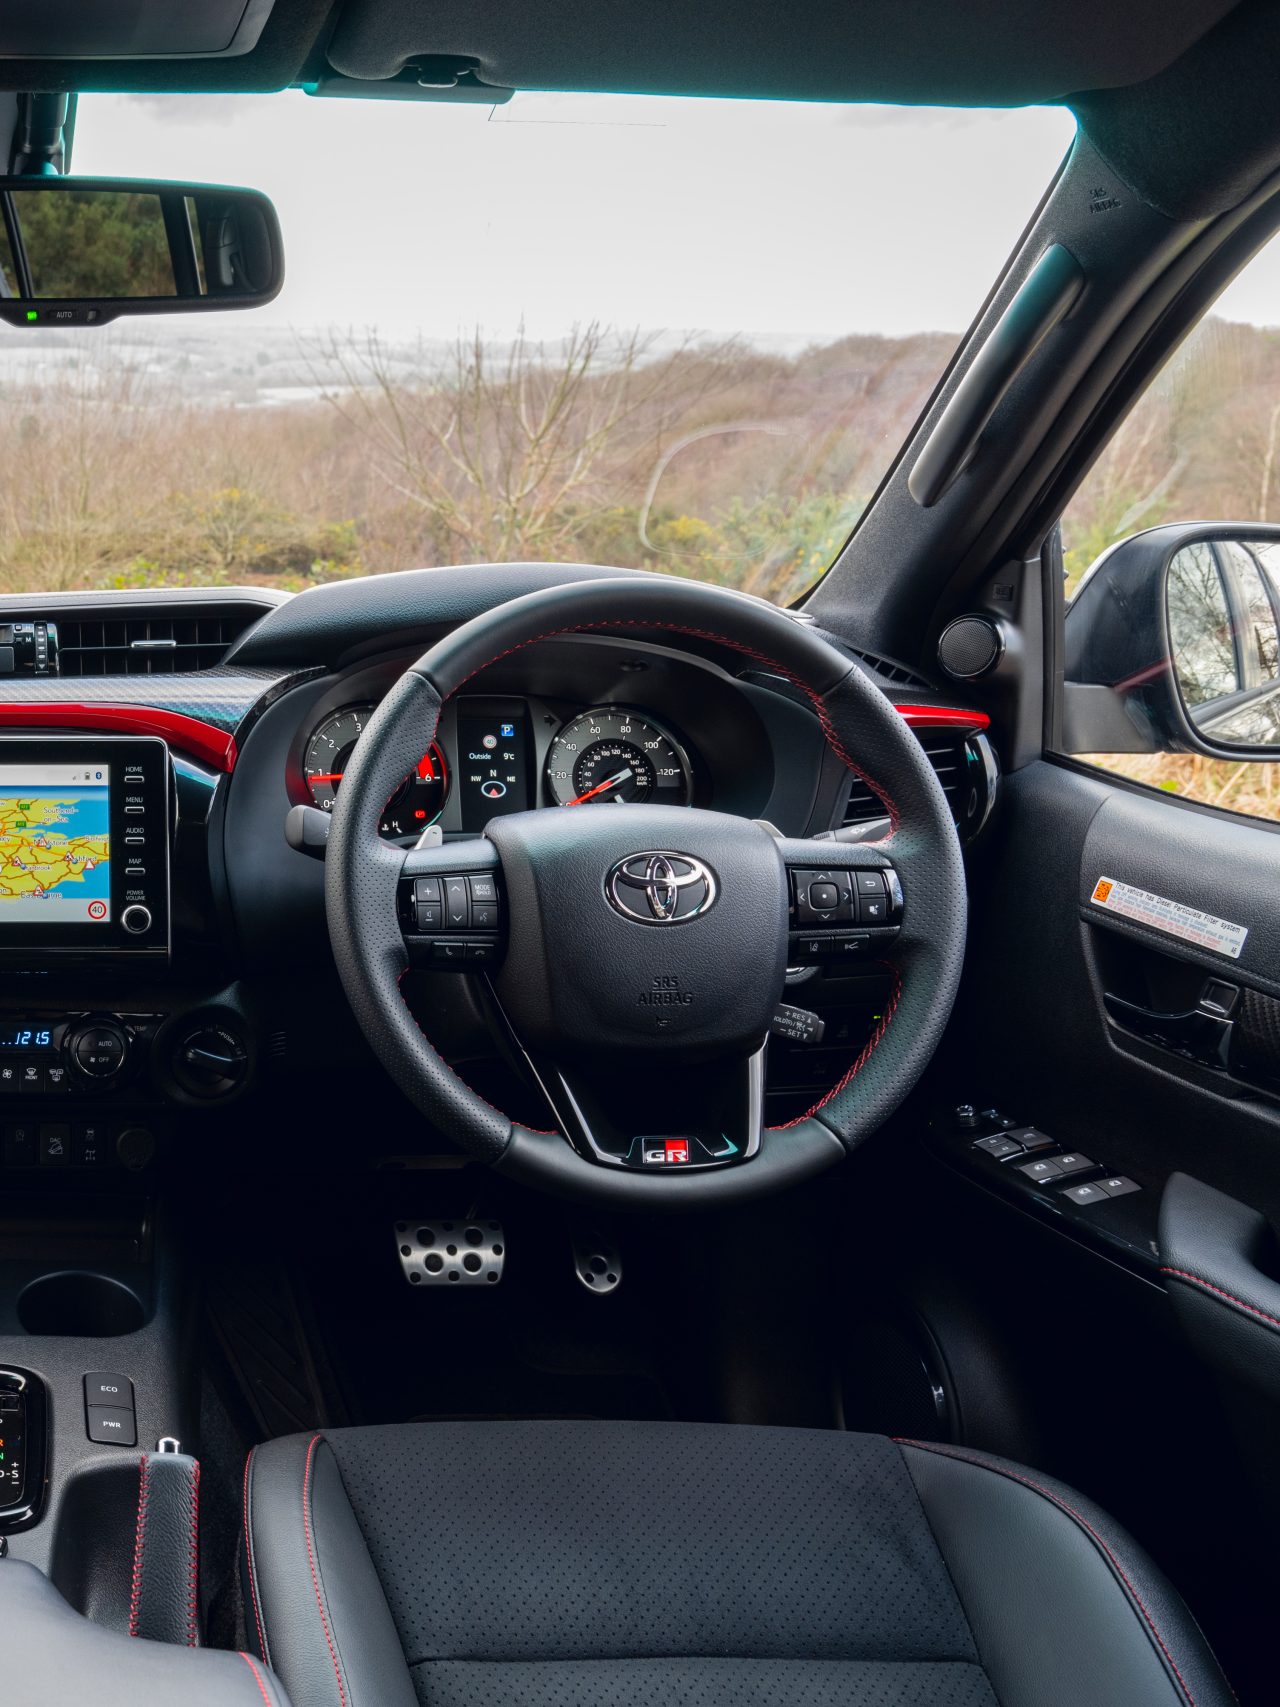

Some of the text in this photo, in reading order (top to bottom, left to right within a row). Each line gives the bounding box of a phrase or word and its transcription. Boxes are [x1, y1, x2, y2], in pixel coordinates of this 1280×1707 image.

[356, 723, 362, 732] 3
[328, 740, 335, 748] 2
[644, 741, 658, 749] 100
[318, 768, 323, 776] 1
[489, 769, 497, 777] N
[323, 800, 330, 808] 0
[1115, 882, 1241, 934] This vehicle has Diesel Particulate Filter system
[652, 976, 679, 988] SRS
[638, 992, 693, 1005] AIRBAG
[791, 1012, 806, 1022] RES
[787, 1028, 801, 1038] SET
[646, 1149, 688, 1161] GR
[100, 1385, 118, 1393] ECO
